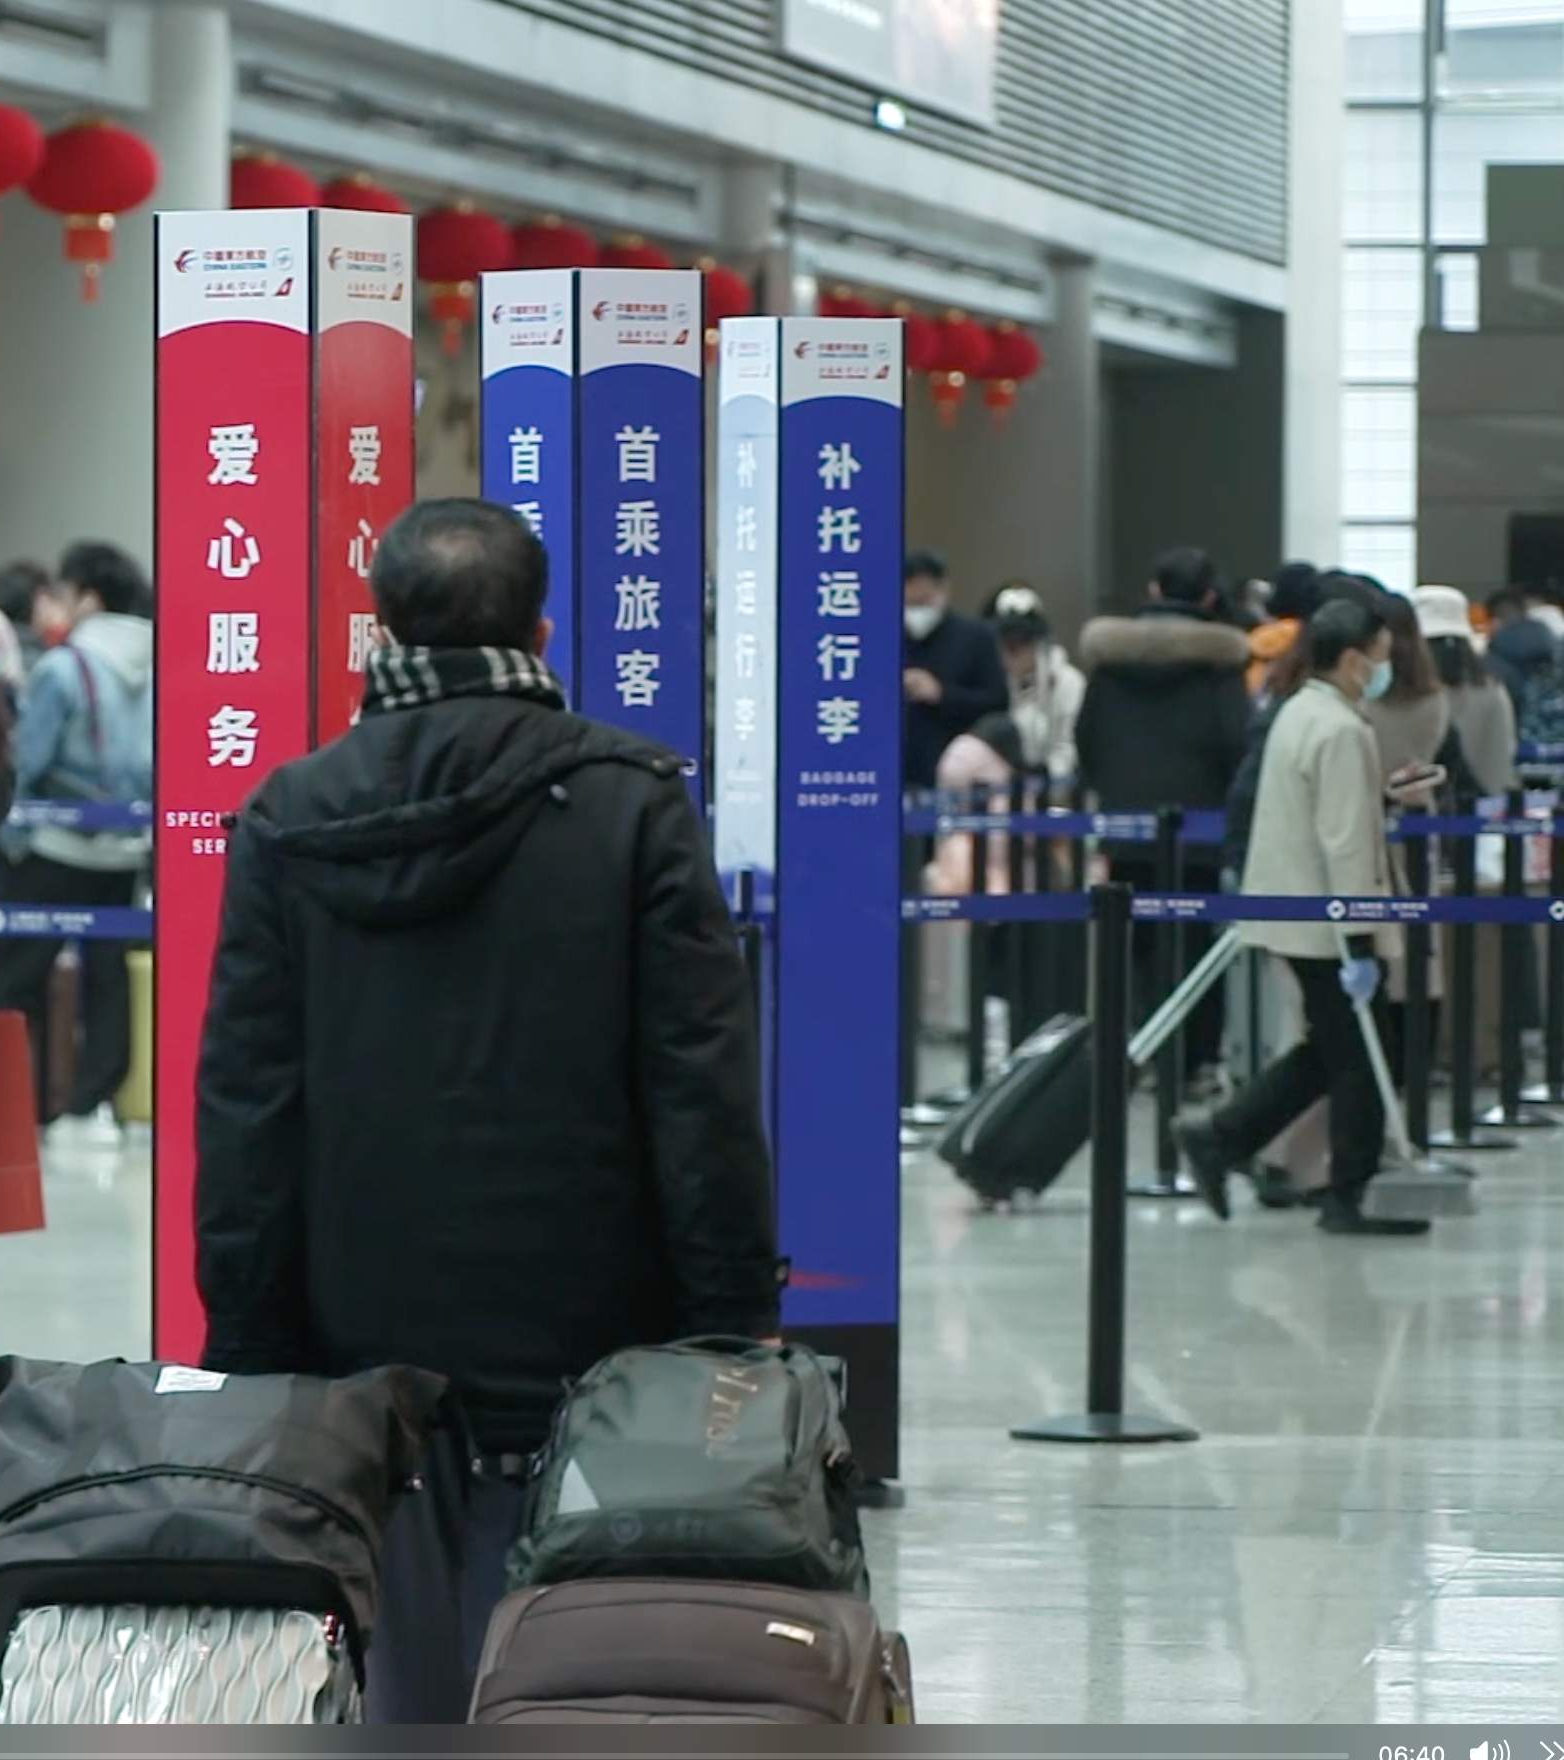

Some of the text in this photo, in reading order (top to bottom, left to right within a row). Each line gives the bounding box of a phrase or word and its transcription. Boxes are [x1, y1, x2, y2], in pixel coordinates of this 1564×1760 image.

[206, 423, 261, 768] 爱心服务
[348, 425, 381, 727] 爱心服
[613, 425, 662, 708] 首乘旅客
[816, 442, 862, 745] 补托运行李
[165, 811, 222, 828] SPECI
[799, 770, 877, 786] BAGGAGE
